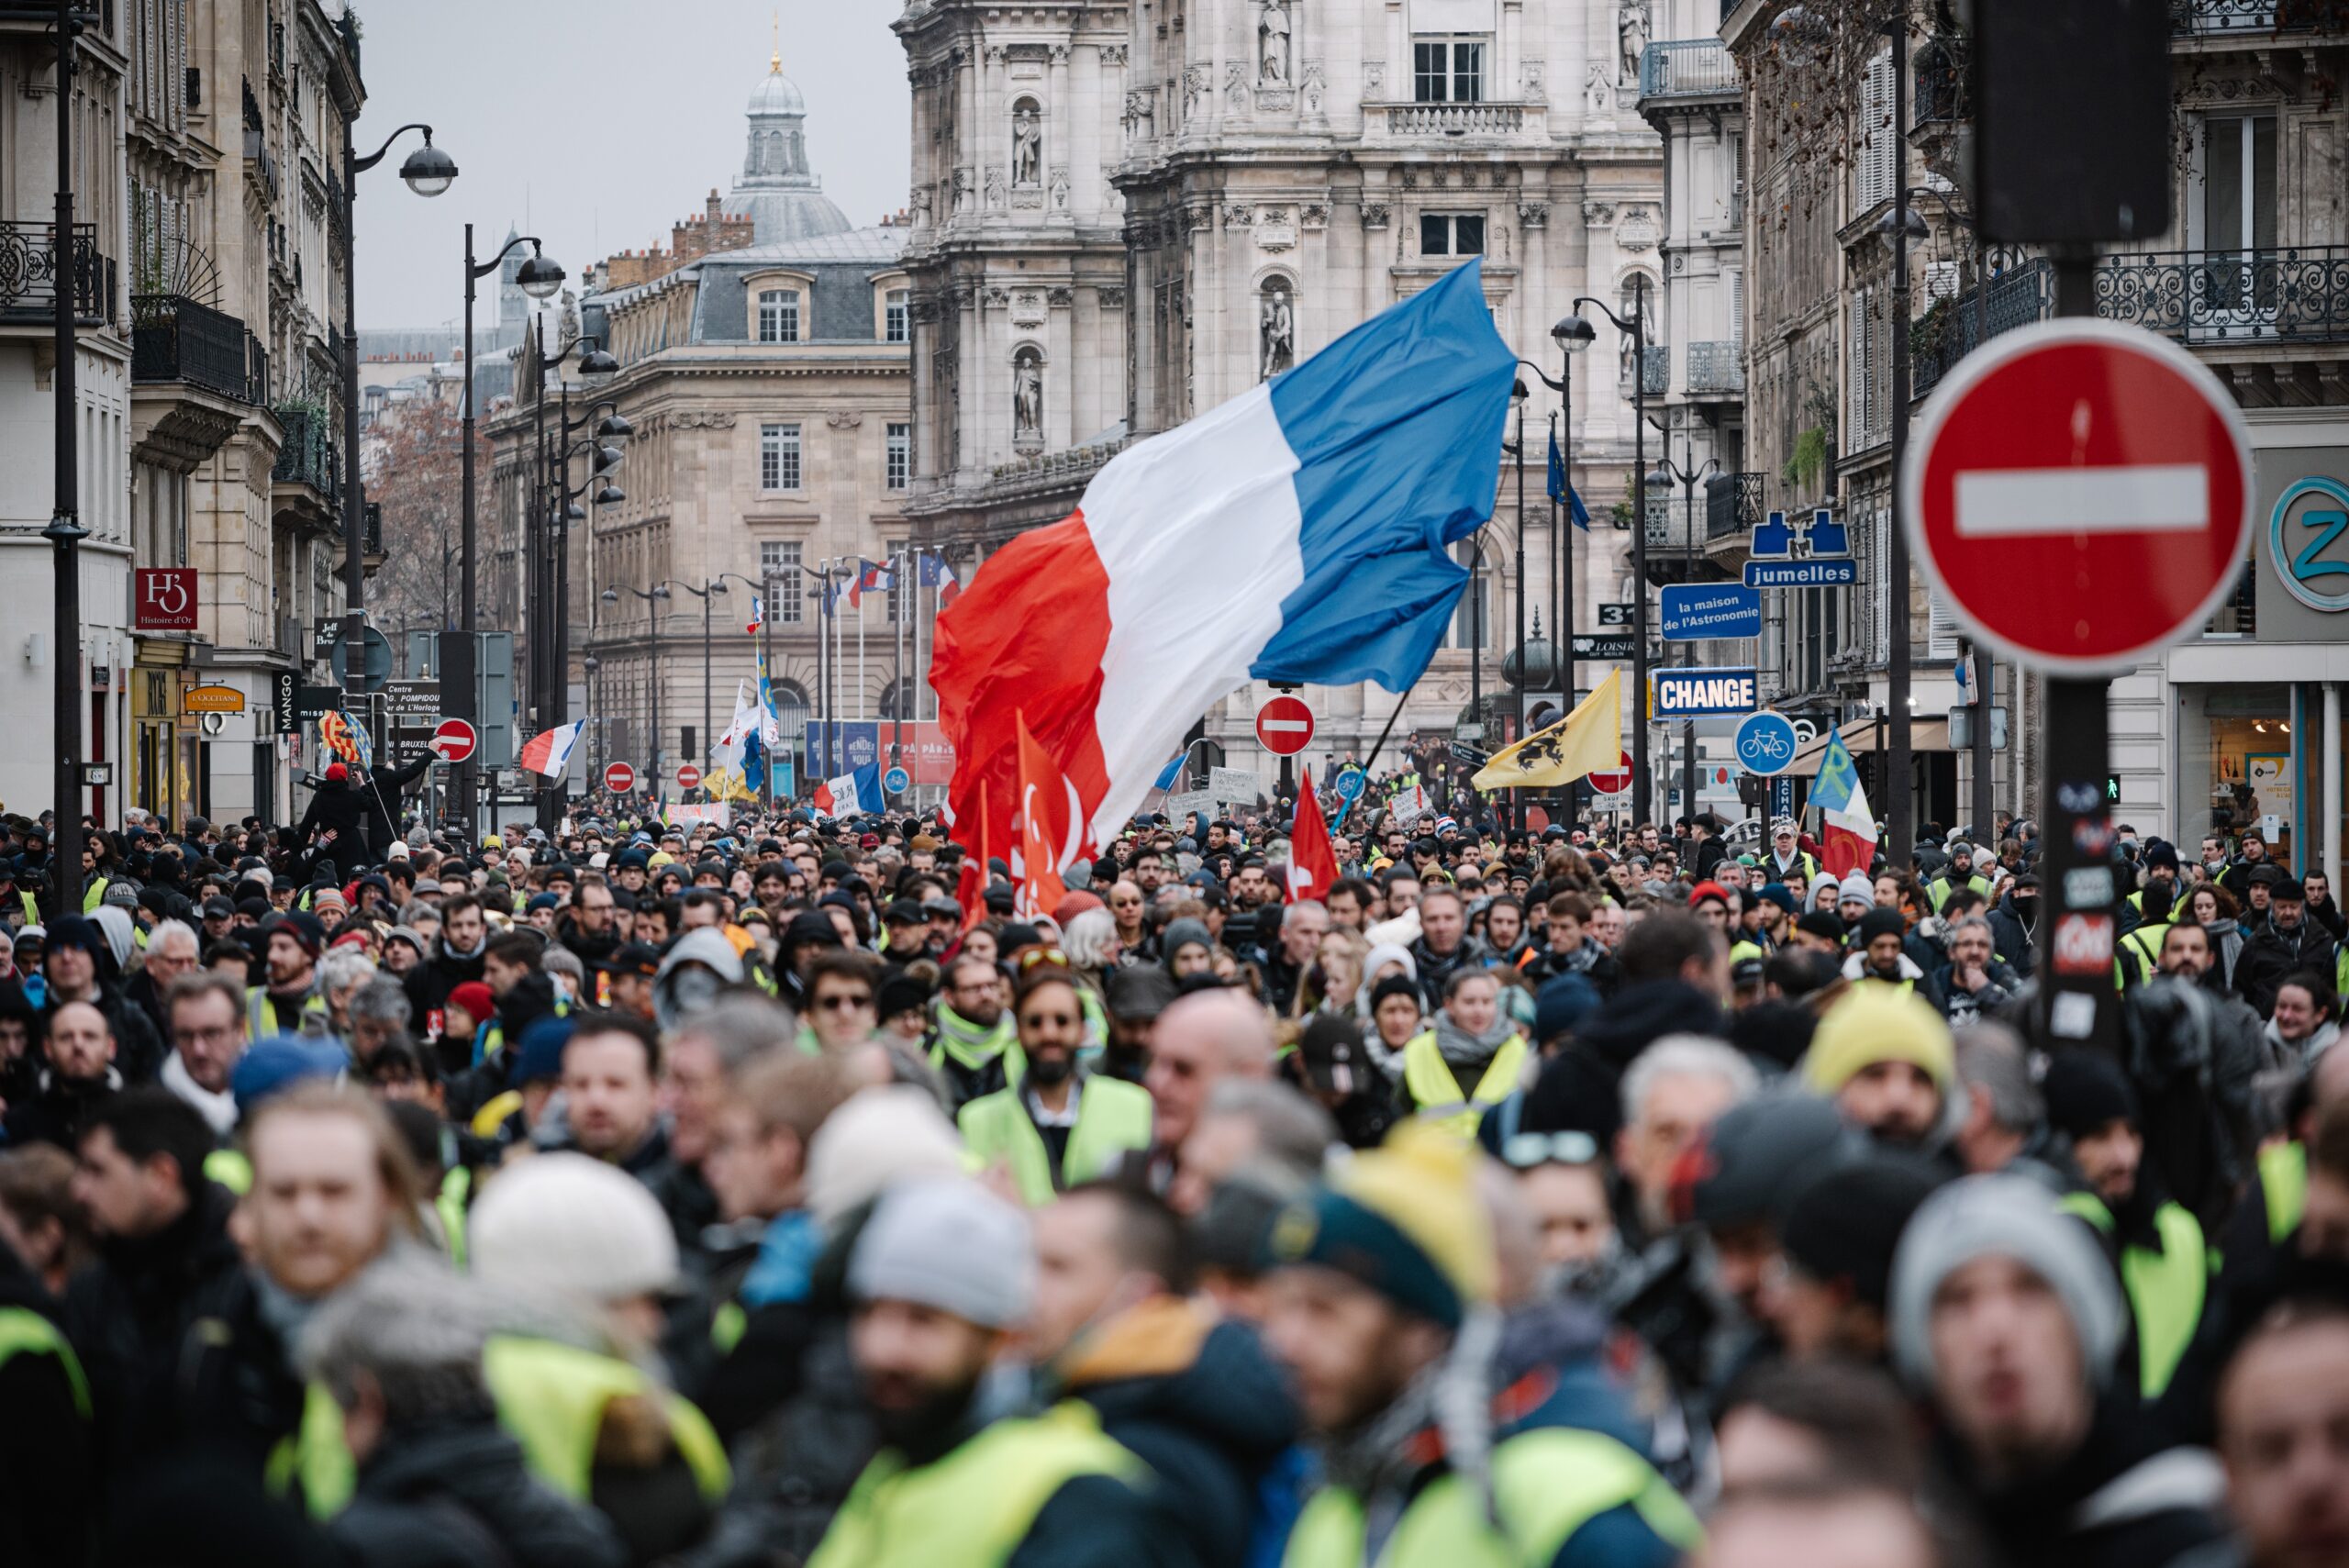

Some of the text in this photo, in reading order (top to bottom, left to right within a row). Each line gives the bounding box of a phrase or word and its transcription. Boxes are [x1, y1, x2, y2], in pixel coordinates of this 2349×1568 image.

[1753, 565, 1851, 586] jumelles
[1678, 596, 1740, 613] la maison
[322, 623, 338, 633] Jeff
[1664, 607, 1759, 631] de l'Astronomie
[316, 635, 336, 645] Bru
[282, 674, 292, 729] MANGO
[1660, 679, 1754, 709] CHANGE
[407, 704, 440, 713] L'Horloge
